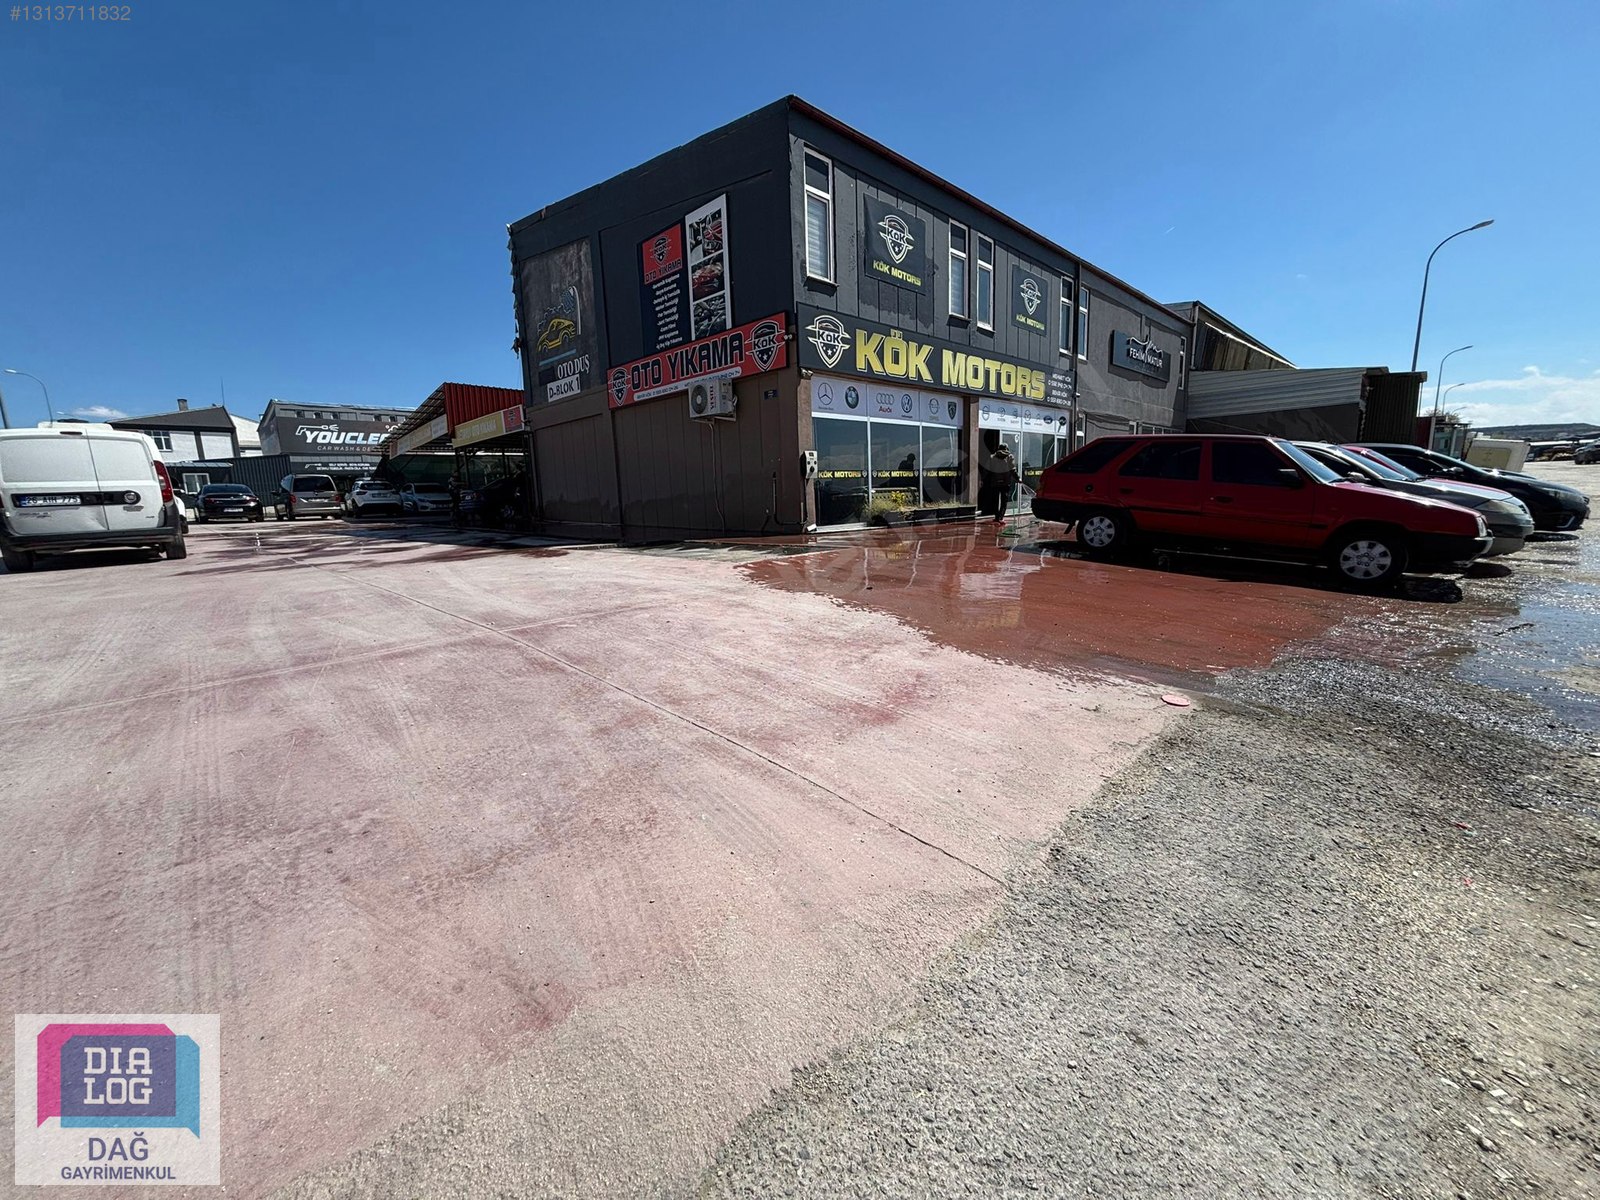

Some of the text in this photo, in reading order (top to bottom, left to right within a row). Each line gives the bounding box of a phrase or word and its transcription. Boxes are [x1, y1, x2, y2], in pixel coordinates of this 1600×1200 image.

[891, 266, 922, 286] MOTORS
[557, 354, 590, 379] OTO DUŞ
[631, 358, 662, 391] OTO
[667, 331, 744, 381] YIKAMA
[855, 329, 1046, 401] KÖK MOTORS
[549, 379, 575, 398] D-BLOK
